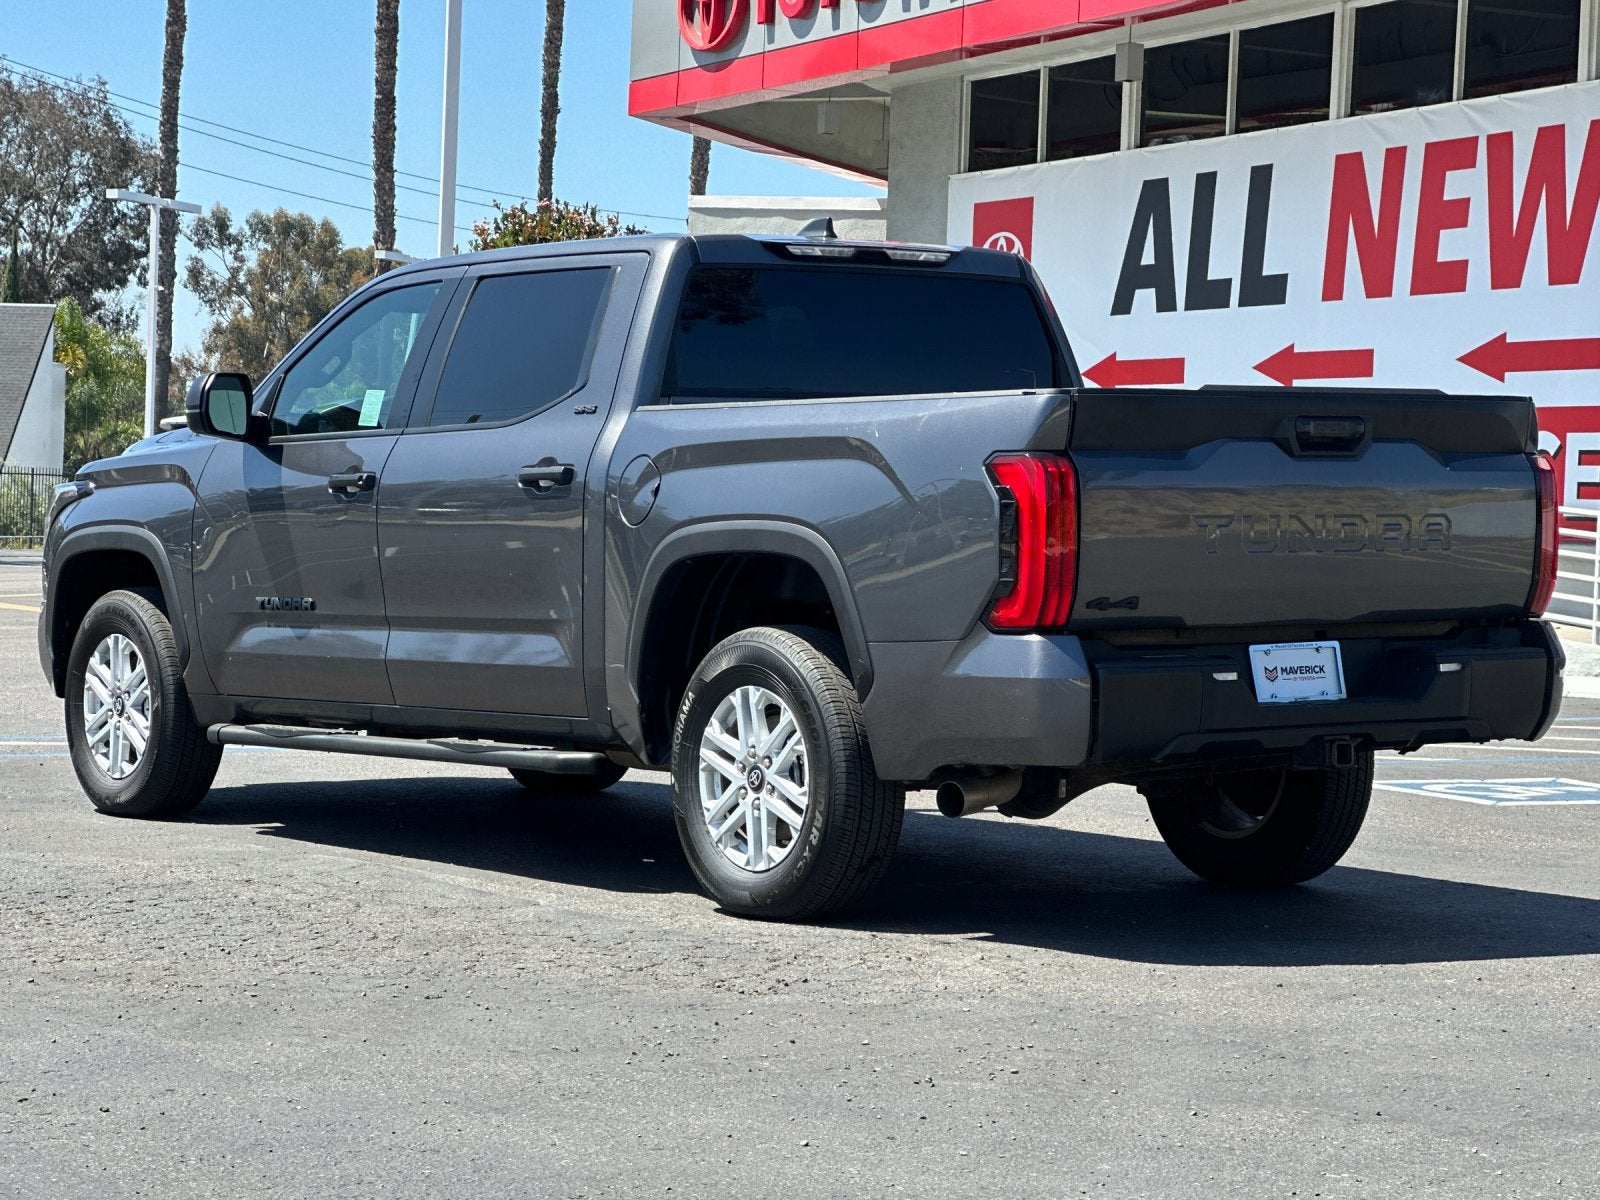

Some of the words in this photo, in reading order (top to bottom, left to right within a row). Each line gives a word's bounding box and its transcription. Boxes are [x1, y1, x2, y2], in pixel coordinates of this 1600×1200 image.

[1110, 163, 1288, 316] ALL
[1321, 119, 1600, 303] NEW
[1191, 513, 1453, 554] TUNDRA
[255, 596, 316, 611] TUNDRA
[1280, 664, 1326, 676] MAVERICK
